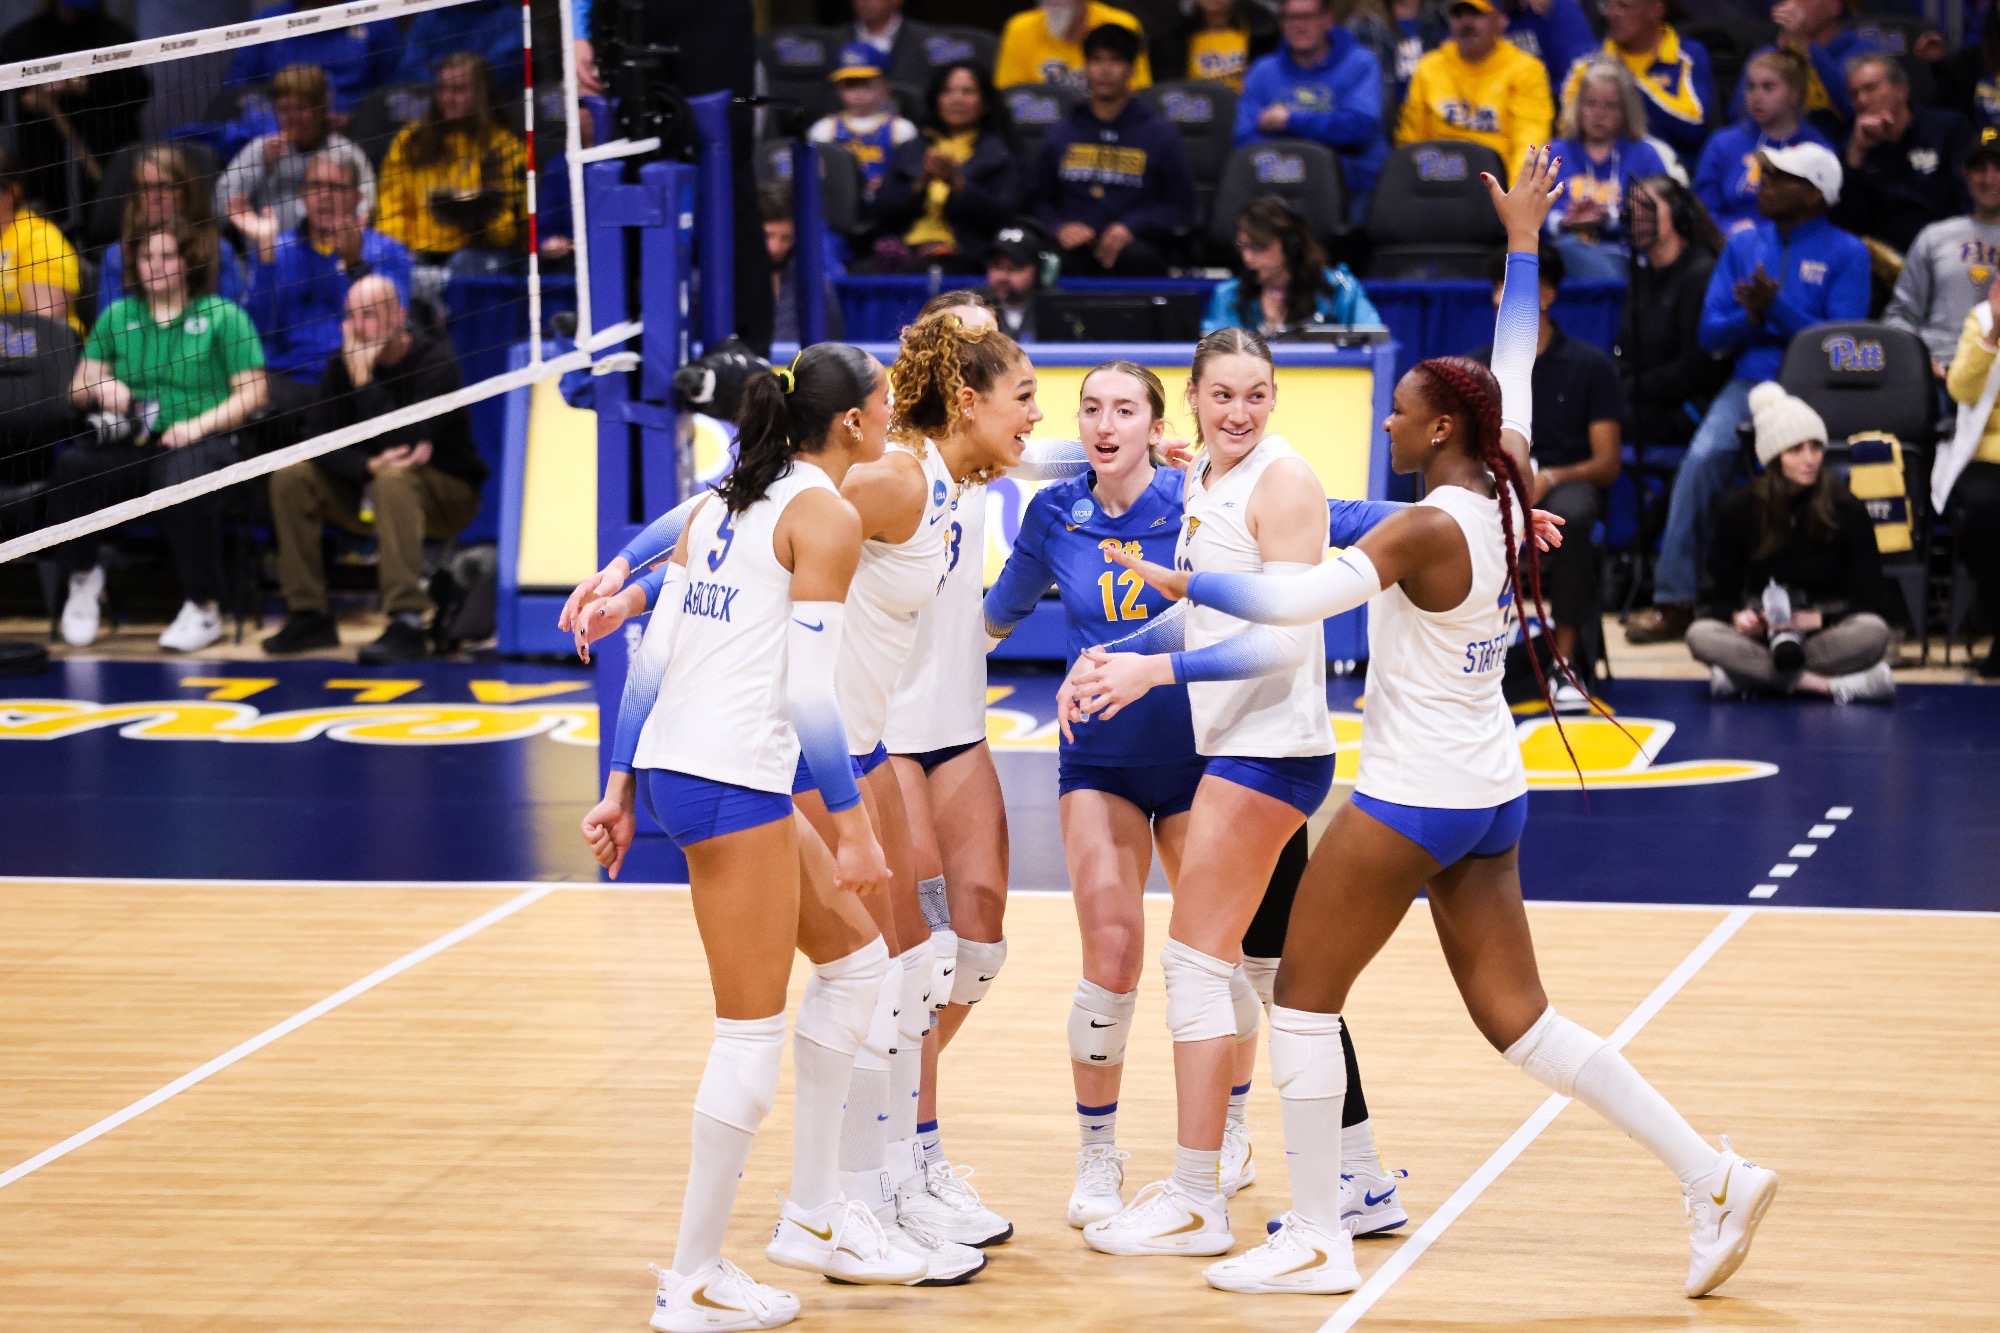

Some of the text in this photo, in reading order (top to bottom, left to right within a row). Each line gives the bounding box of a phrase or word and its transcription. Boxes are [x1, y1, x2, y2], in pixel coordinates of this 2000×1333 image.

[1822, 333, 1886, 372] Pitt
[1073, 510, 1093, 518] NCAA
[707, 509, 735, 574] 5
[1098, 538, 1144, 563] Ptt
[683, 581, 740, 623] ABCOCK
[1097, 568, 1149, 622] 12
